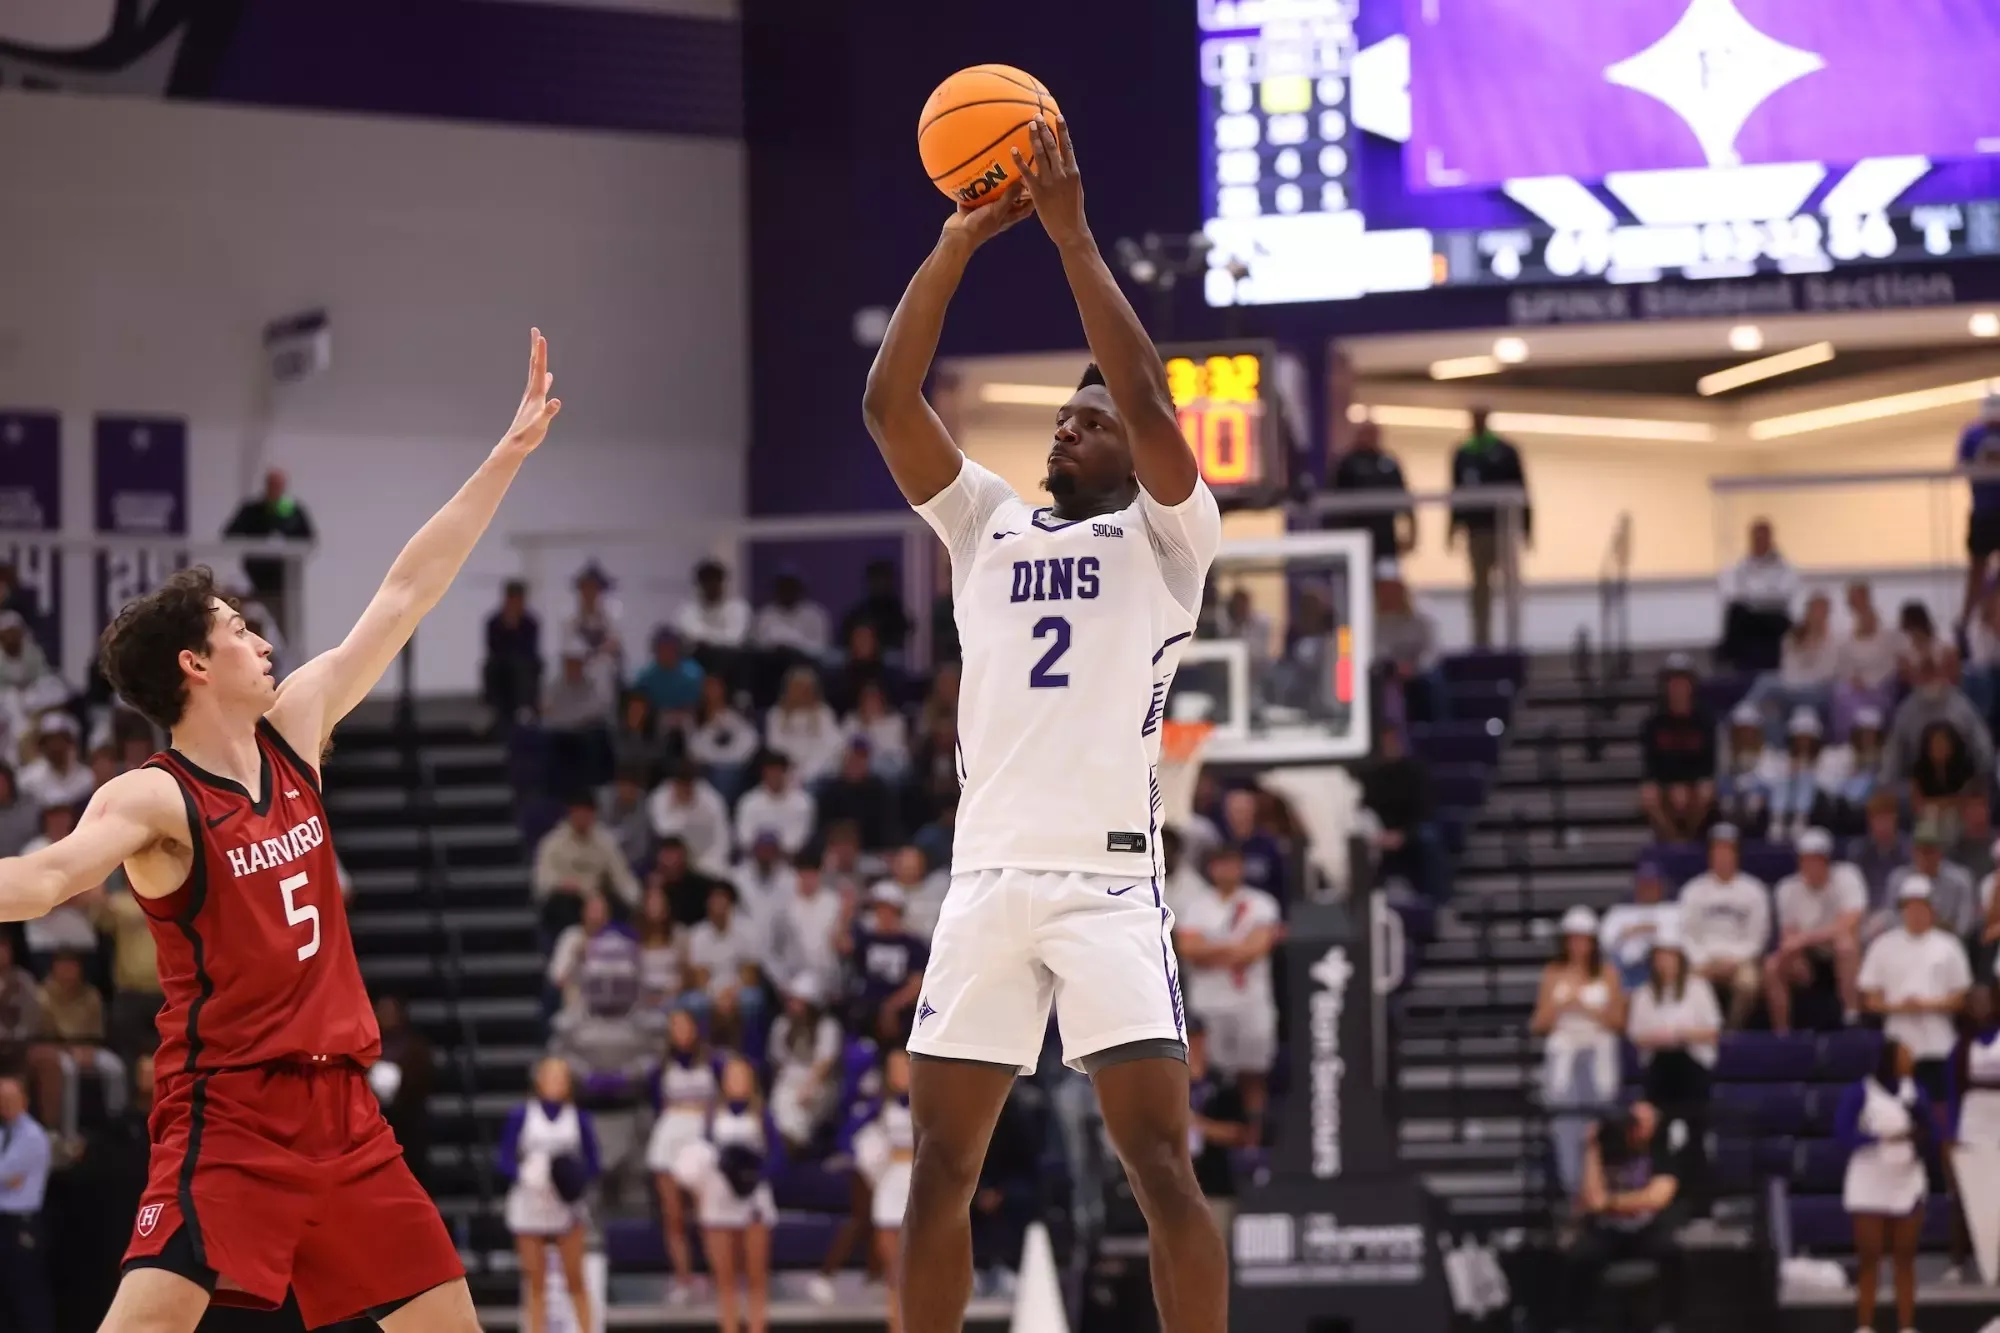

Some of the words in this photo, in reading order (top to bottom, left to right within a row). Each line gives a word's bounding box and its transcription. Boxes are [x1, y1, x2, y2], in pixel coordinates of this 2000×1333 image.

[1010, 556, 1100, 604] DINS
[1028, 615, 1072, 689] 2
[226, 815, 324, 878] HARVARD
[279, 871, 321, 962] 5
[140, 1207, 158, 1226] H
